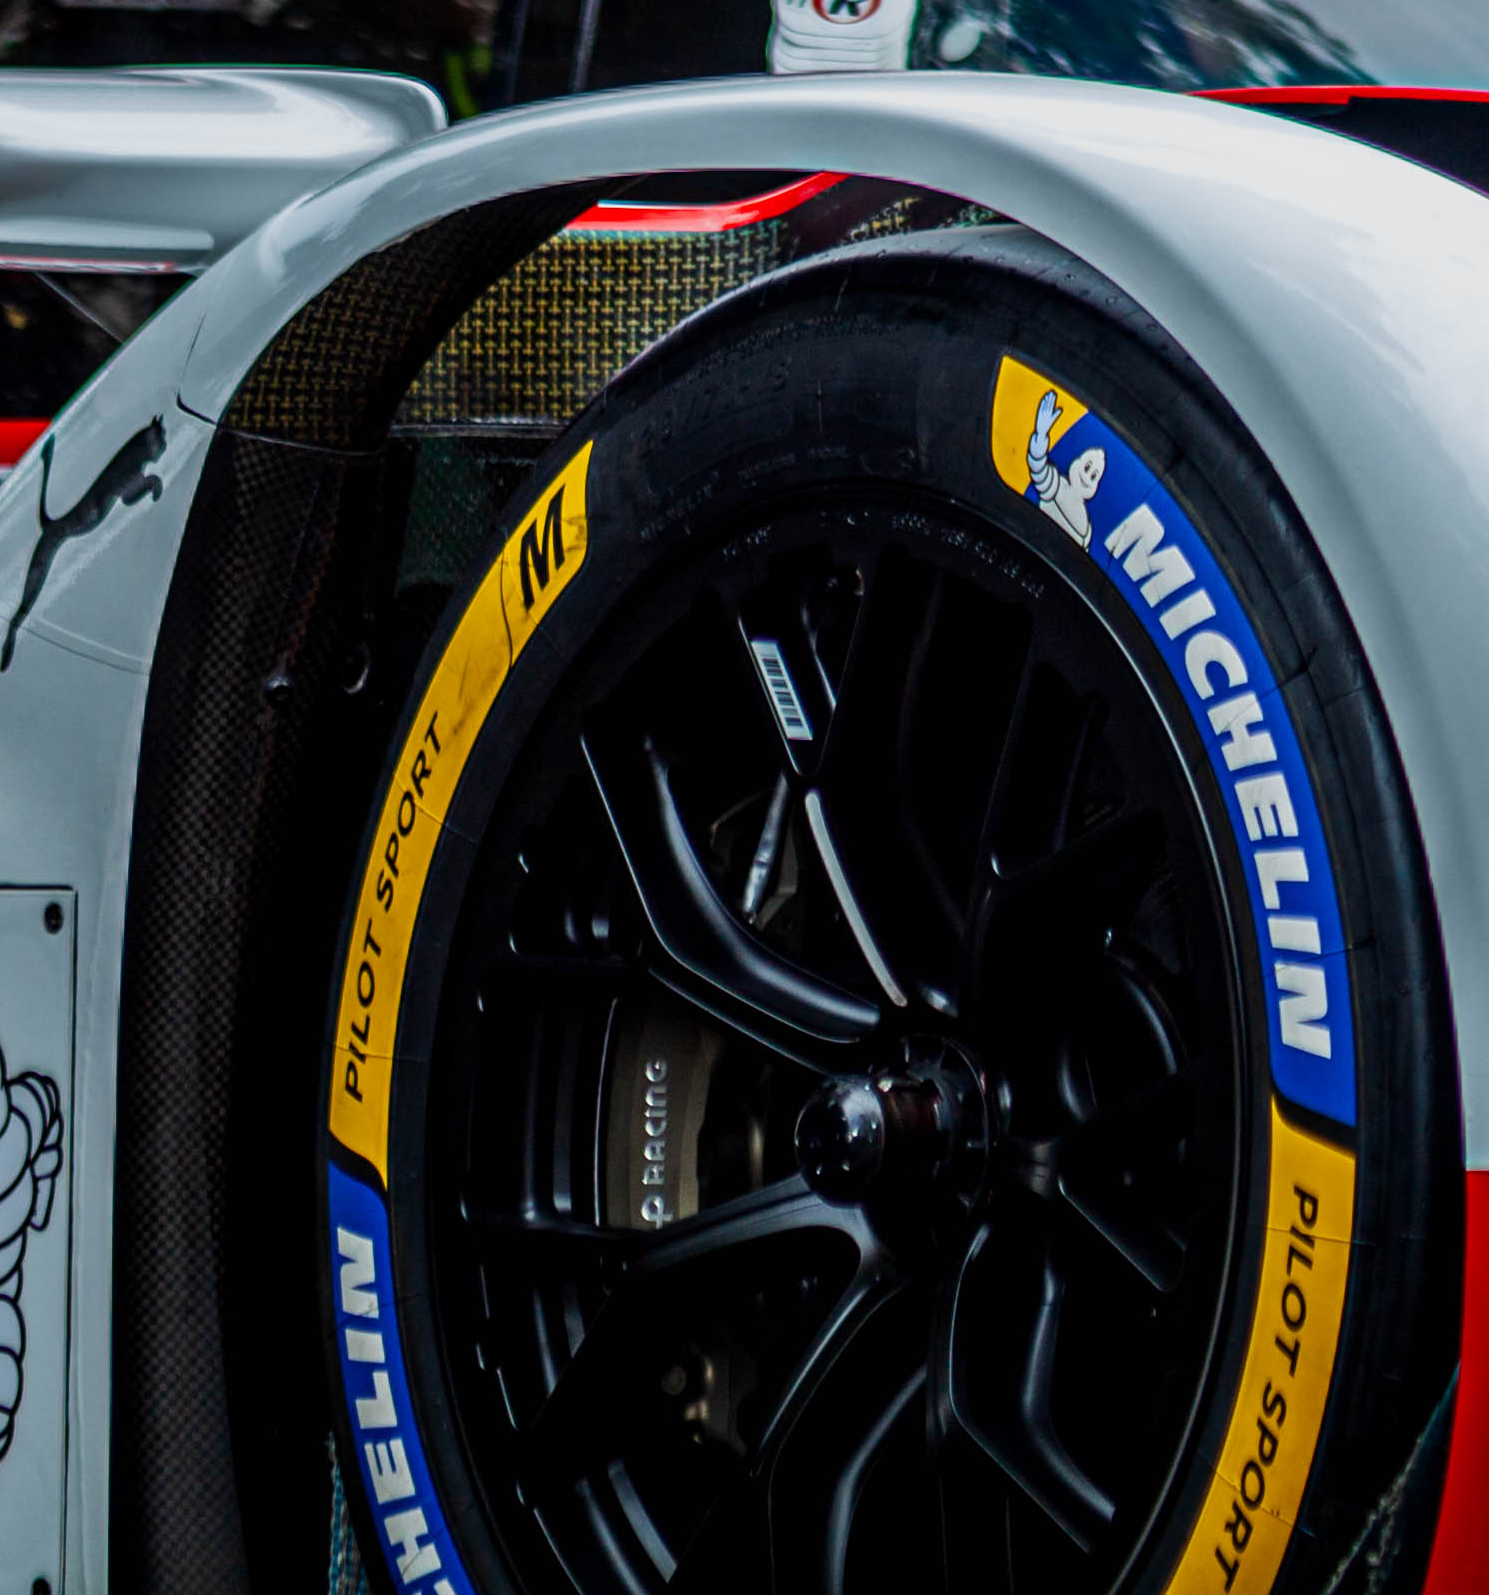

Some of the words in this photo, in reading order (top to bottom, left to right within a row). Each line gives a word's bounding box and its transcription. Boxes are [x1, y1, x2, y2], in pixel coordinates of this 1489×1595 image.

[517, 483, 567, 612] M
[1103, 502, 1332, 1061] MICHELIN
[344, 914, 384, 1104] PILOT
[374, 710, 445, 914] SPORT
[642, 1060, 668, 1186] RACING
[1274, 1183, 1320, 1379] PILOT
[1213, 1380, 1288, 1595] SPORT
